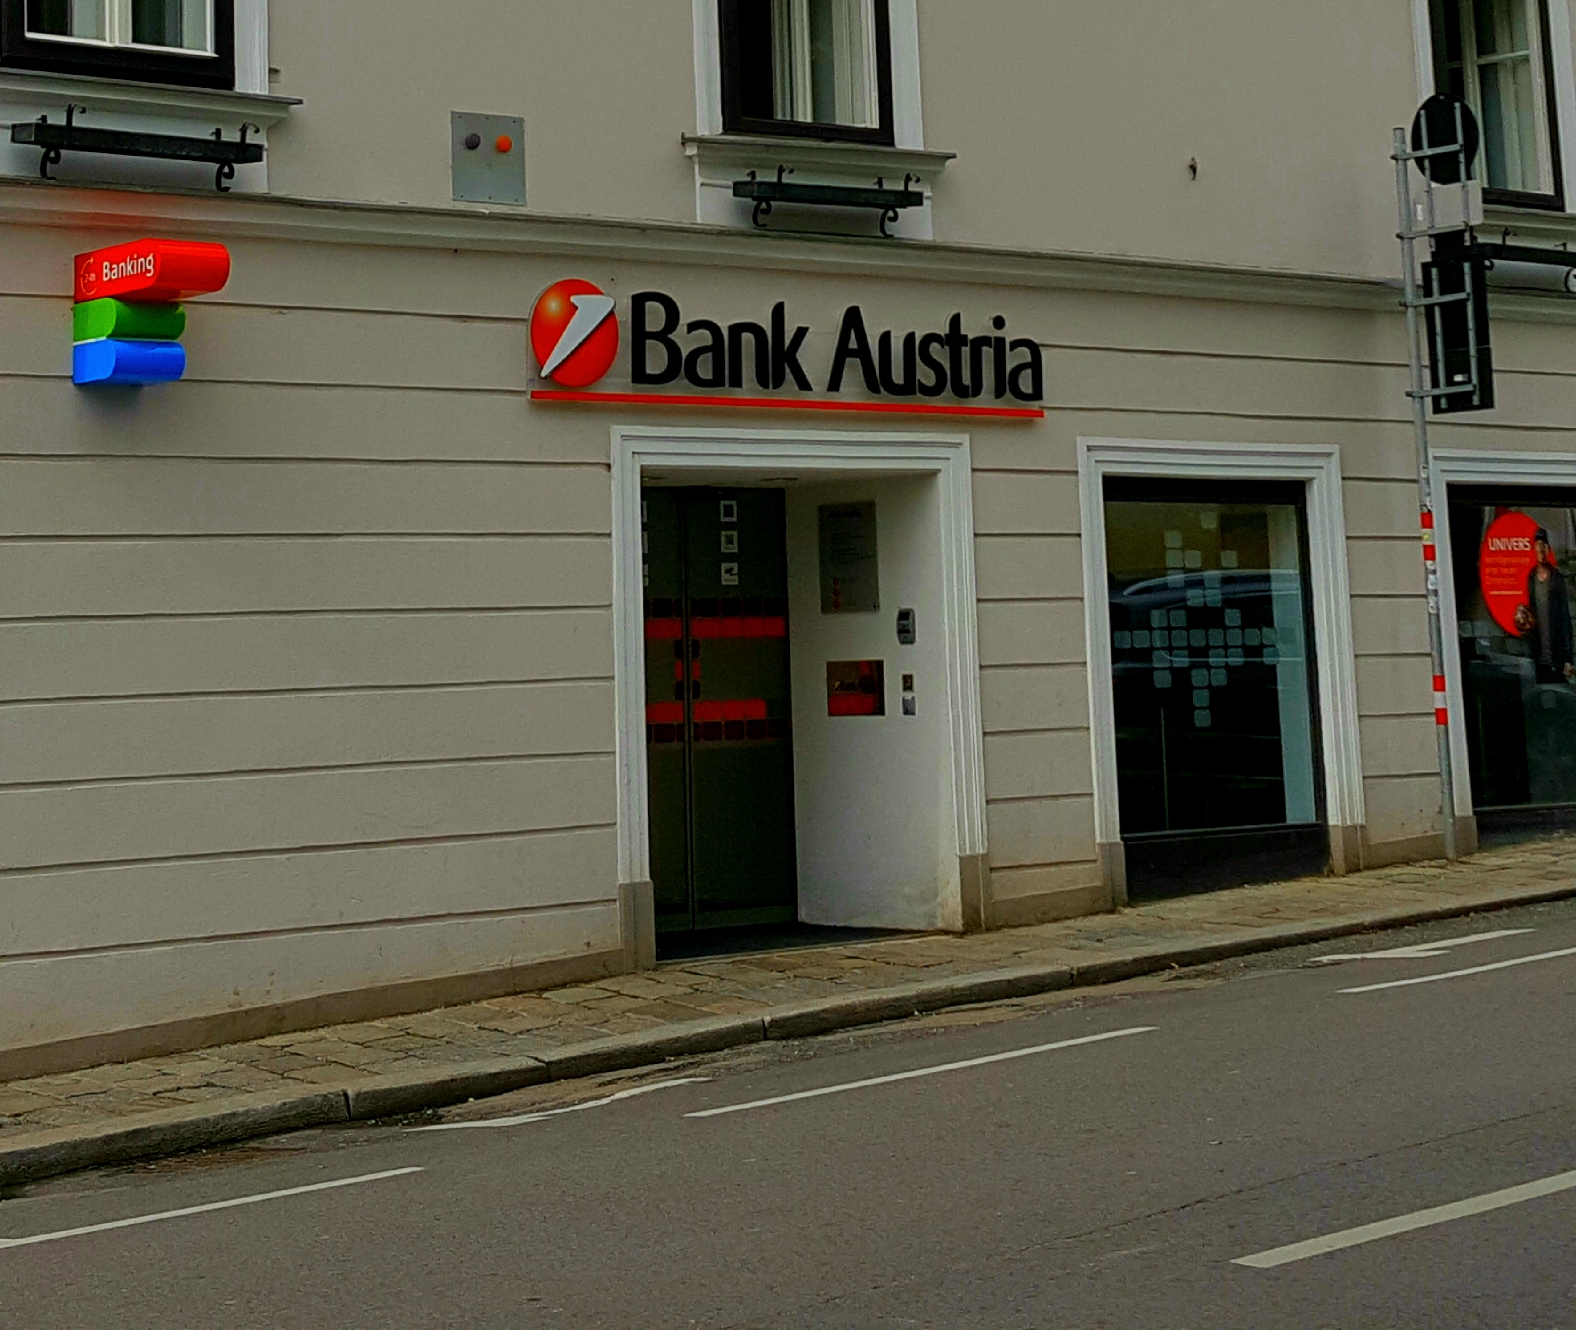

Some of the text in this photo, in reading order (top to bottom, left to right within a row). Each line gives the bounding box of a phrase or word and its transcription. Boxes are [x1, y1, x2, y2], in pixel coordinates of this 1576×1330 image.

[103, 253, 154, 281] Banking
[631, 291, 1044, 402] Bank Austria
